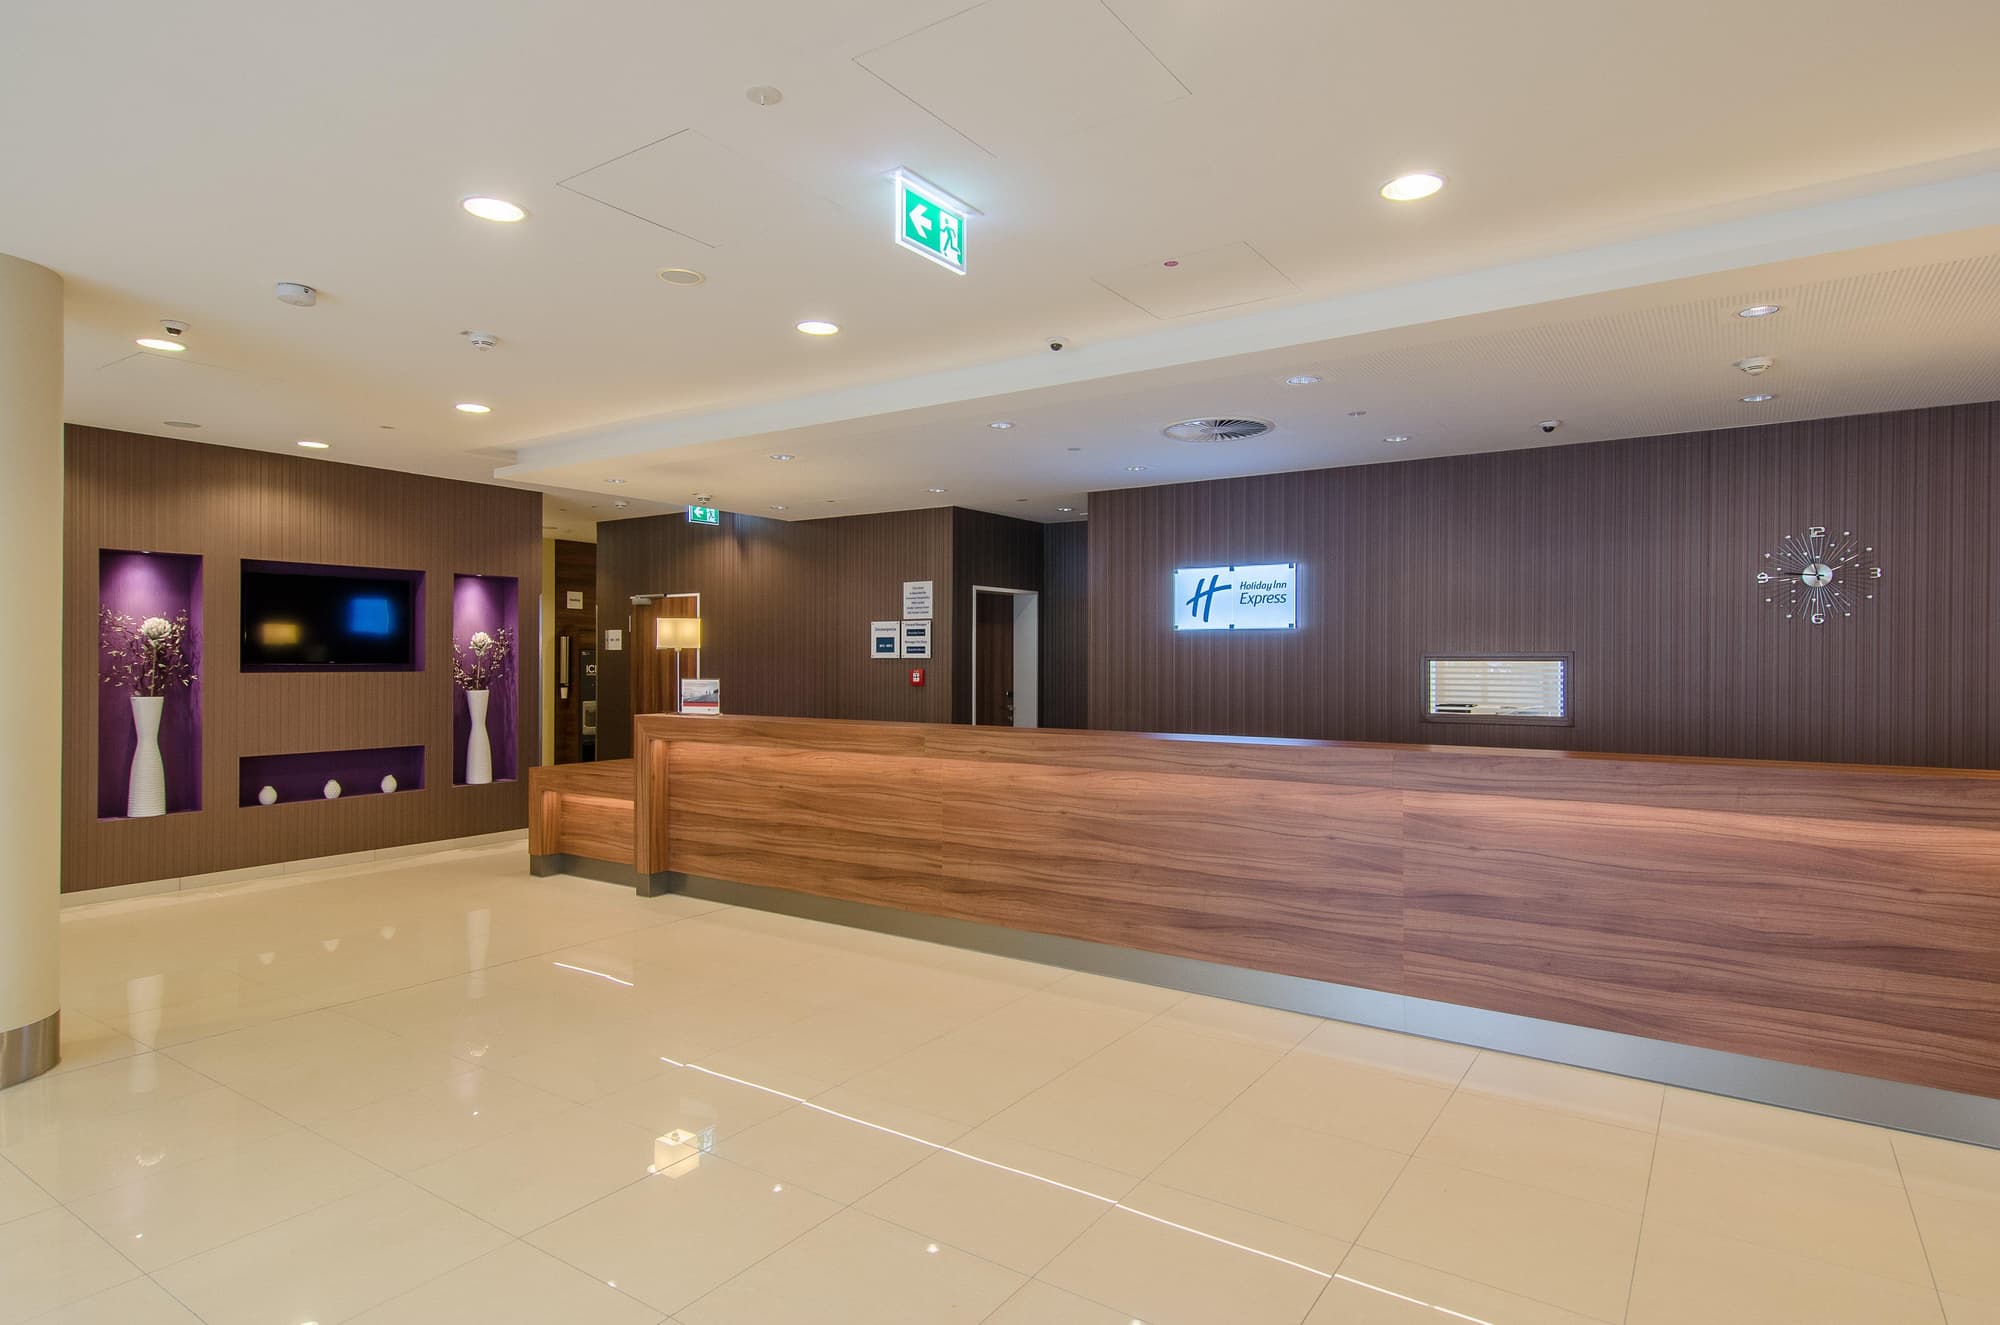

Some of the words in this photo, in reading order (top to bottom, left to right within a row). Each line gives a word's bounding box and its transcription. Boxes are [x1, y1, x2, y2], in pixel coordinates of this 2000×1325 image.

[1808, 526, 1826, 538] 12
[1756, 572, 1769, 584] 9
[1869, 567, 1882, 579] 3
[1239, 581, 1273, 591] Holiday
[1273, 580, 1287, 589] Inn
[1239, 592, 1287, 607] Express
[1811, 613, 1825, 624] 6
[585, 664, 598, 673] IC
